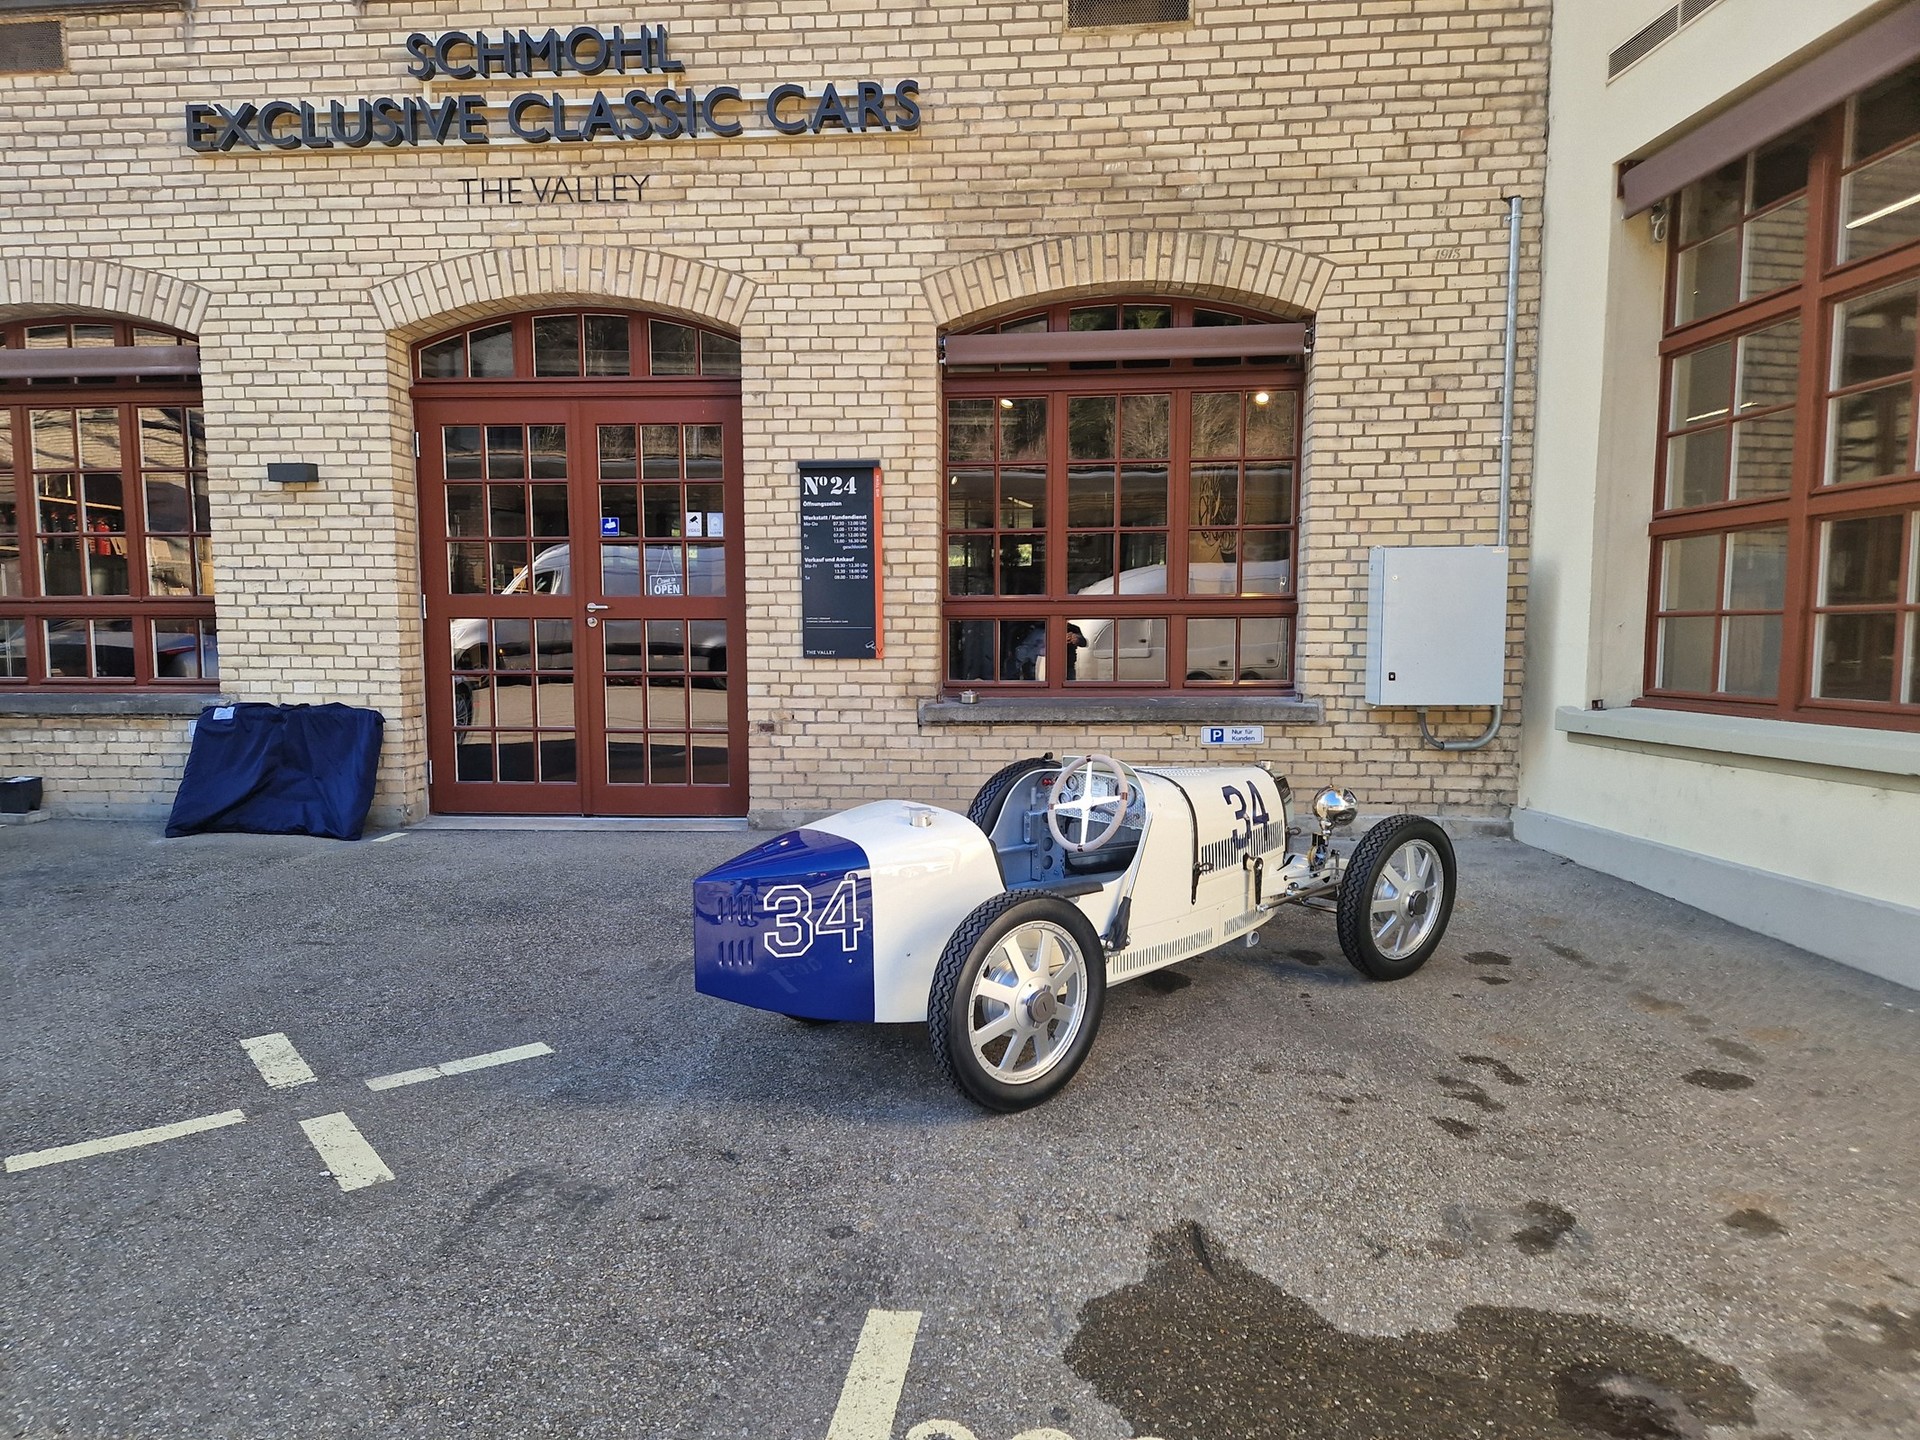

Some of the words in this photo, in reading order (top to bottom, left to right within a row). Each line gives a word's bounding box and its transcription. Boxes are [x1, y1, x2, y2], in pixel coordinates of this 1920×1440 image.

[406, 24, 685, 81] SCHMOHL
[185, 94, 489, 152] EXCLUSIVE
[508, 86, 743, 143] CLASSIC
[766, 79, 921, 134] CARS
[458, 176, 523, 206] THE
[530, 174, 650, 204] VALLEY
[654, 584, 680, 594] OPEN
[1212, 730, 1222, 741] P
[1221, 780, 1270, 850] 34
[763, 880, 864, 958] 34
